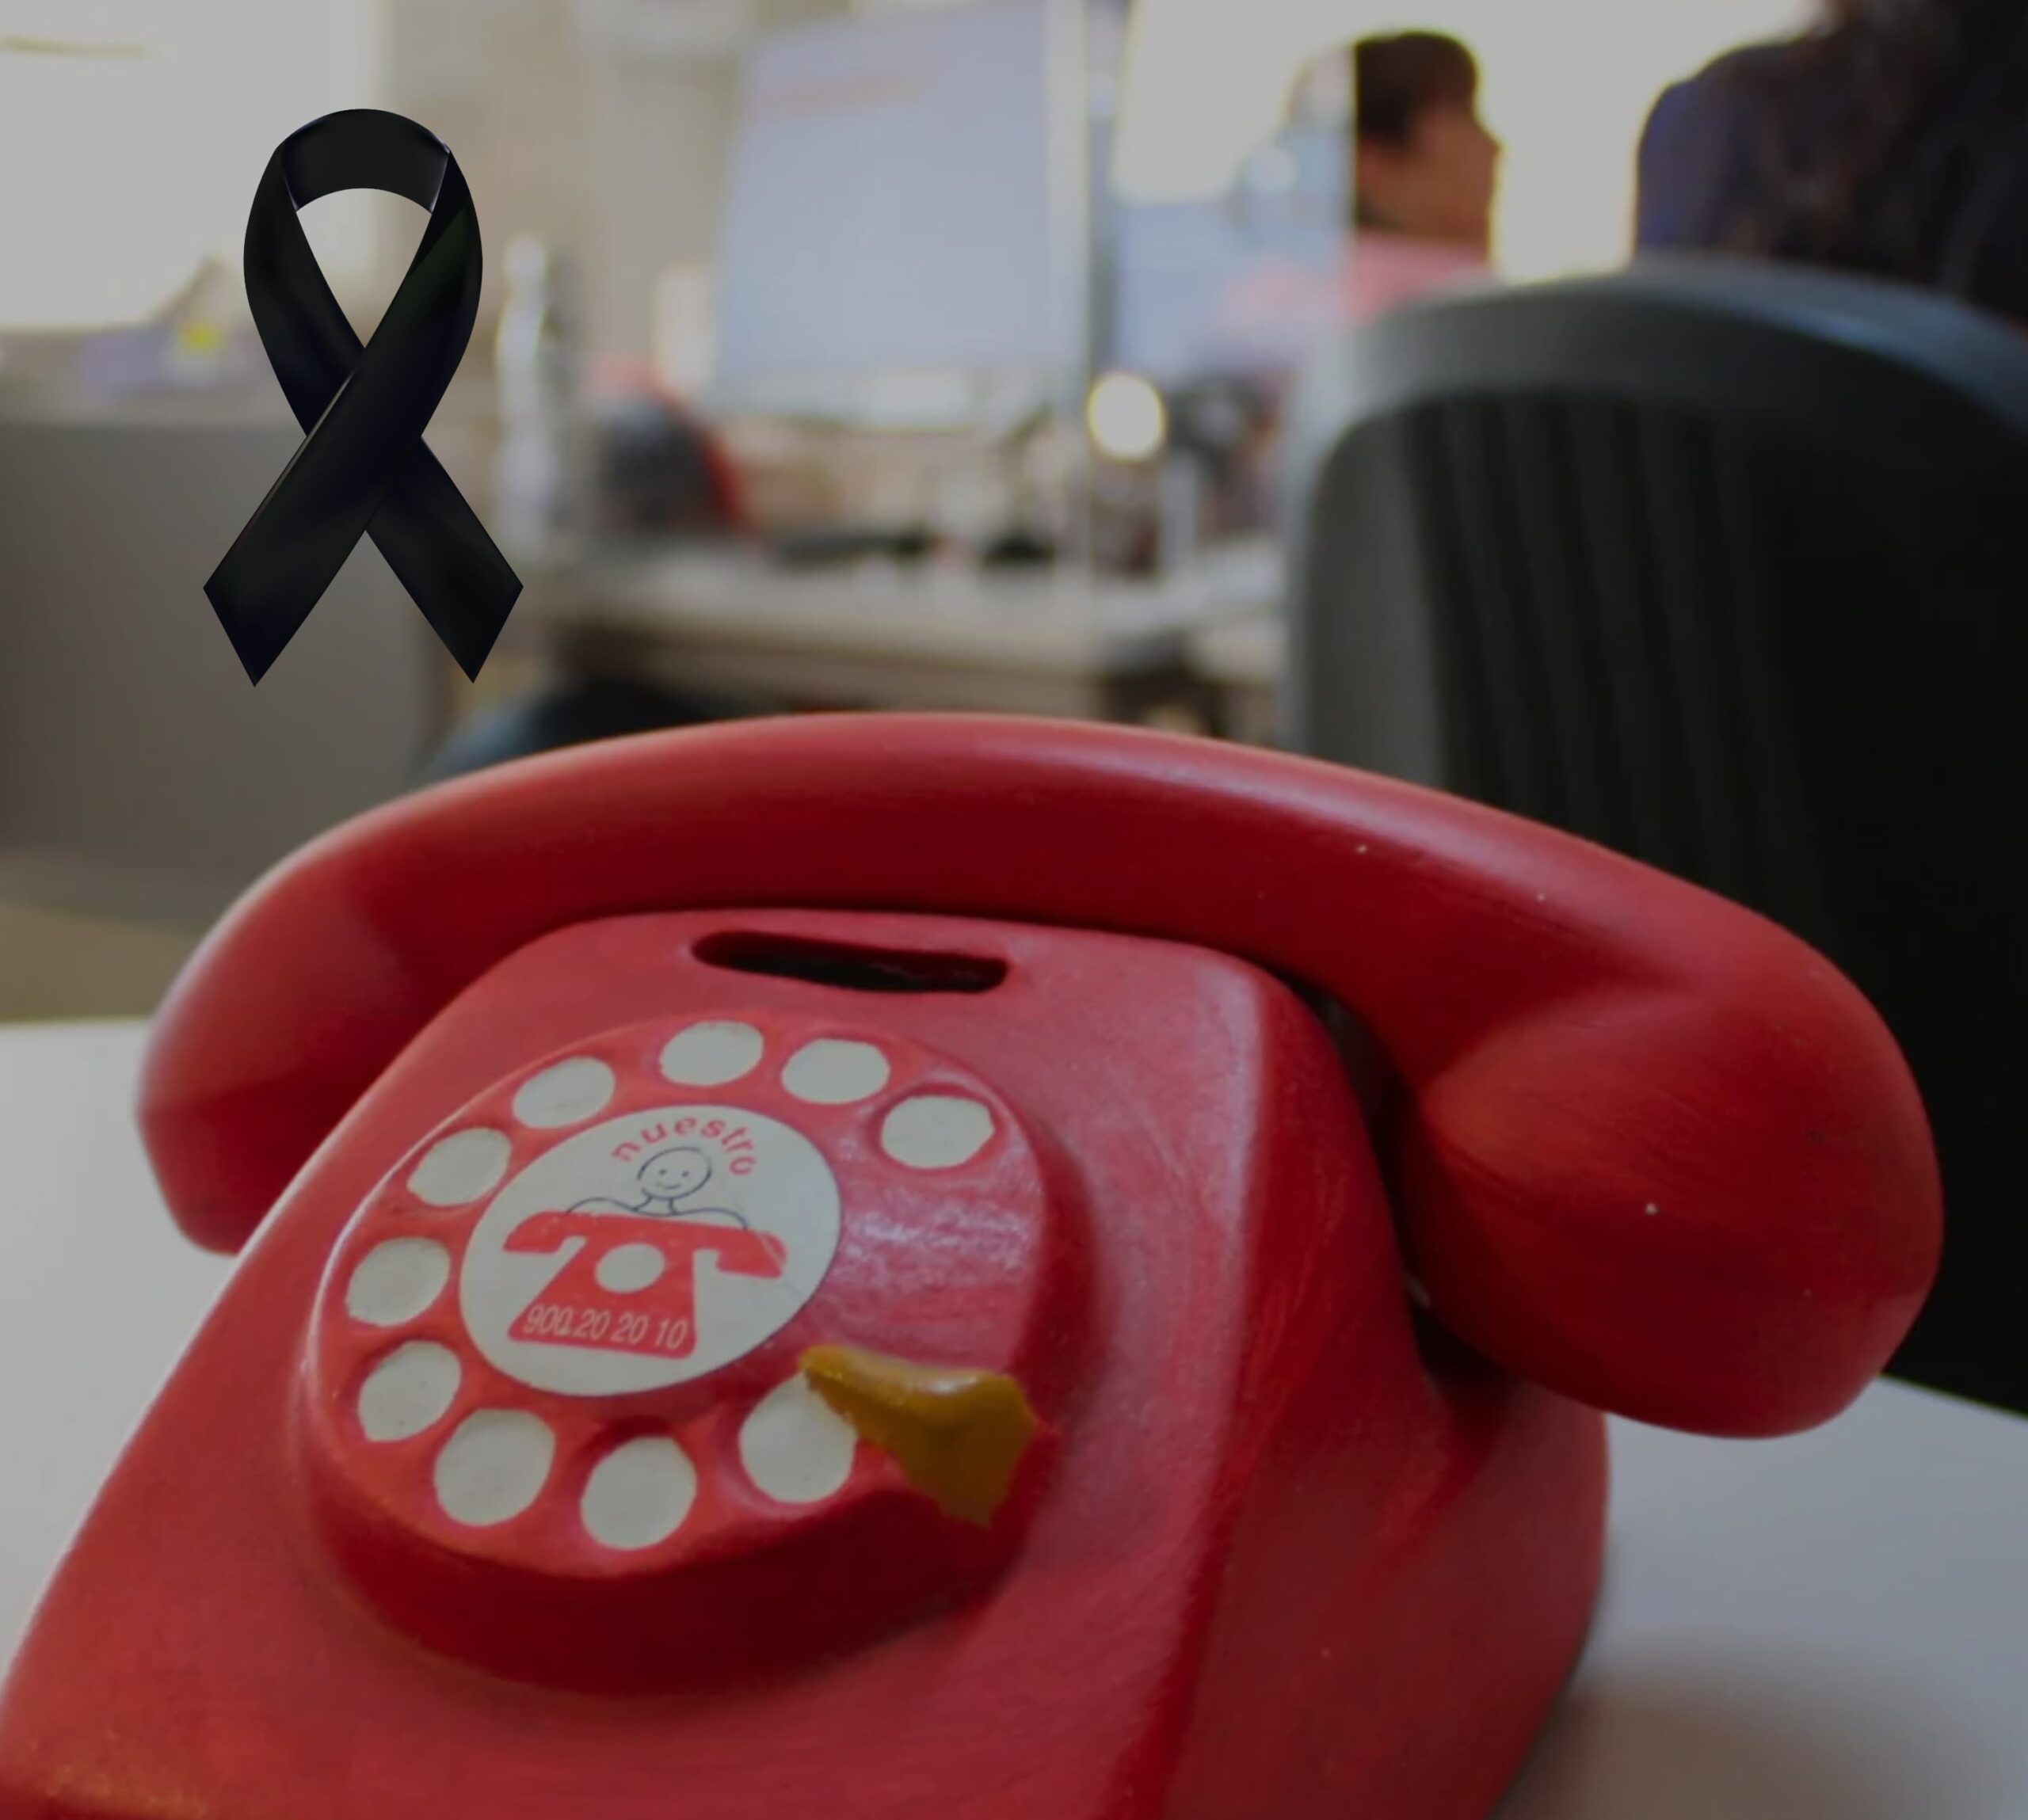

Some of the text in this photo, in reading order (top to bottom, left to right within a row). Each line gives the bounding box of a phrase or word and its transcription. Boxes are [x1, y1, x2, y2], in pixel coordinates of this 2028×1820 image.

[612, 1117, 757, 1175] nuestro
[611, 1312, 649, 1345] 20
[654, 1318, 689, 1350] 10
